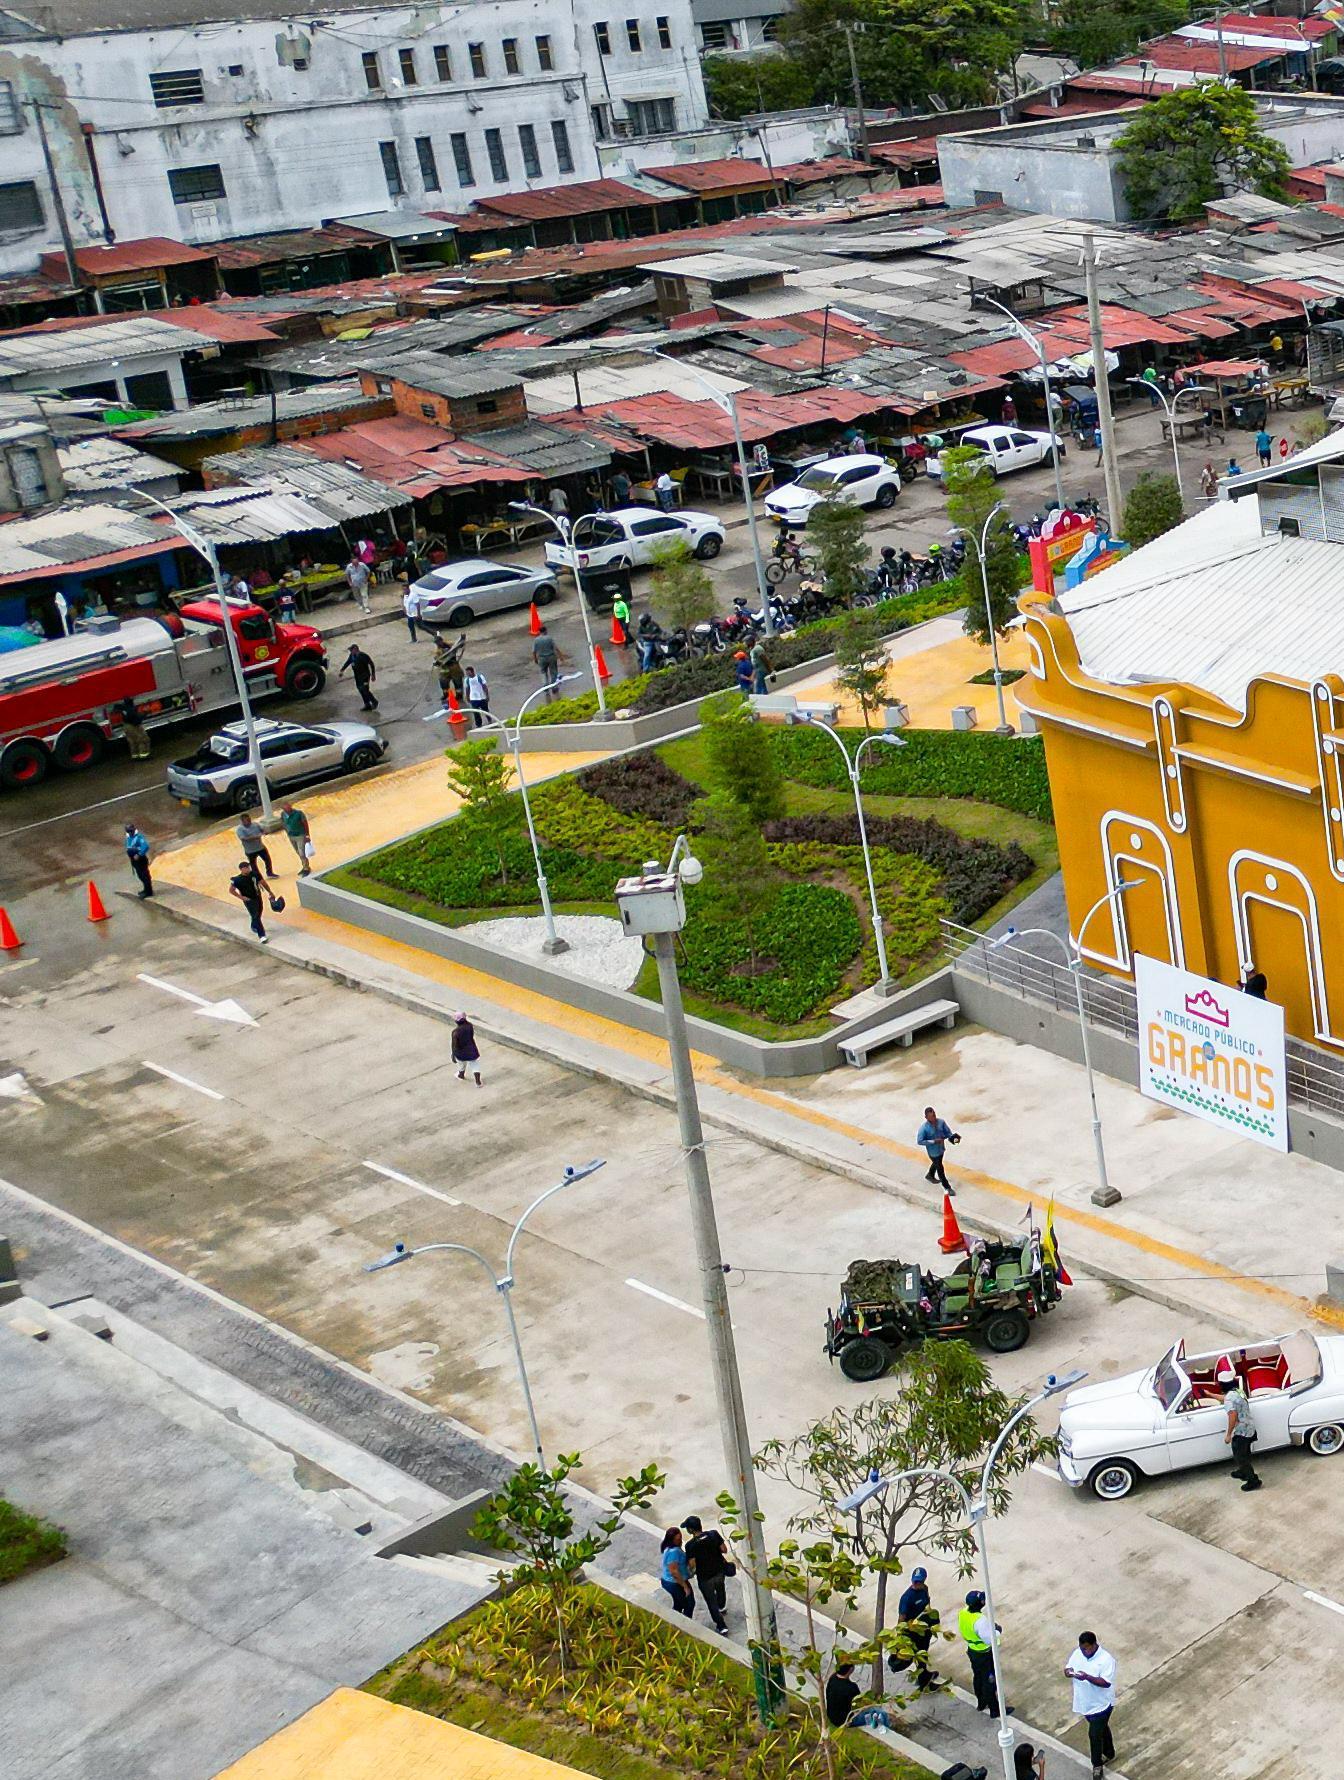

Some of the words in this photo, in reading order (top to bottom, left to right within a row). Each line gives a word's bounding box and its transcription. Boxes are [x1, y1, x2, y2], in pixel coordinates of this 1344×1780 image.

[1147, 1022, 1275, 1111] GRANOS
[1164, 1010, 1210, 1039] MERCADO
[1214, 1029, 1255, 1056] PÚBLICO
